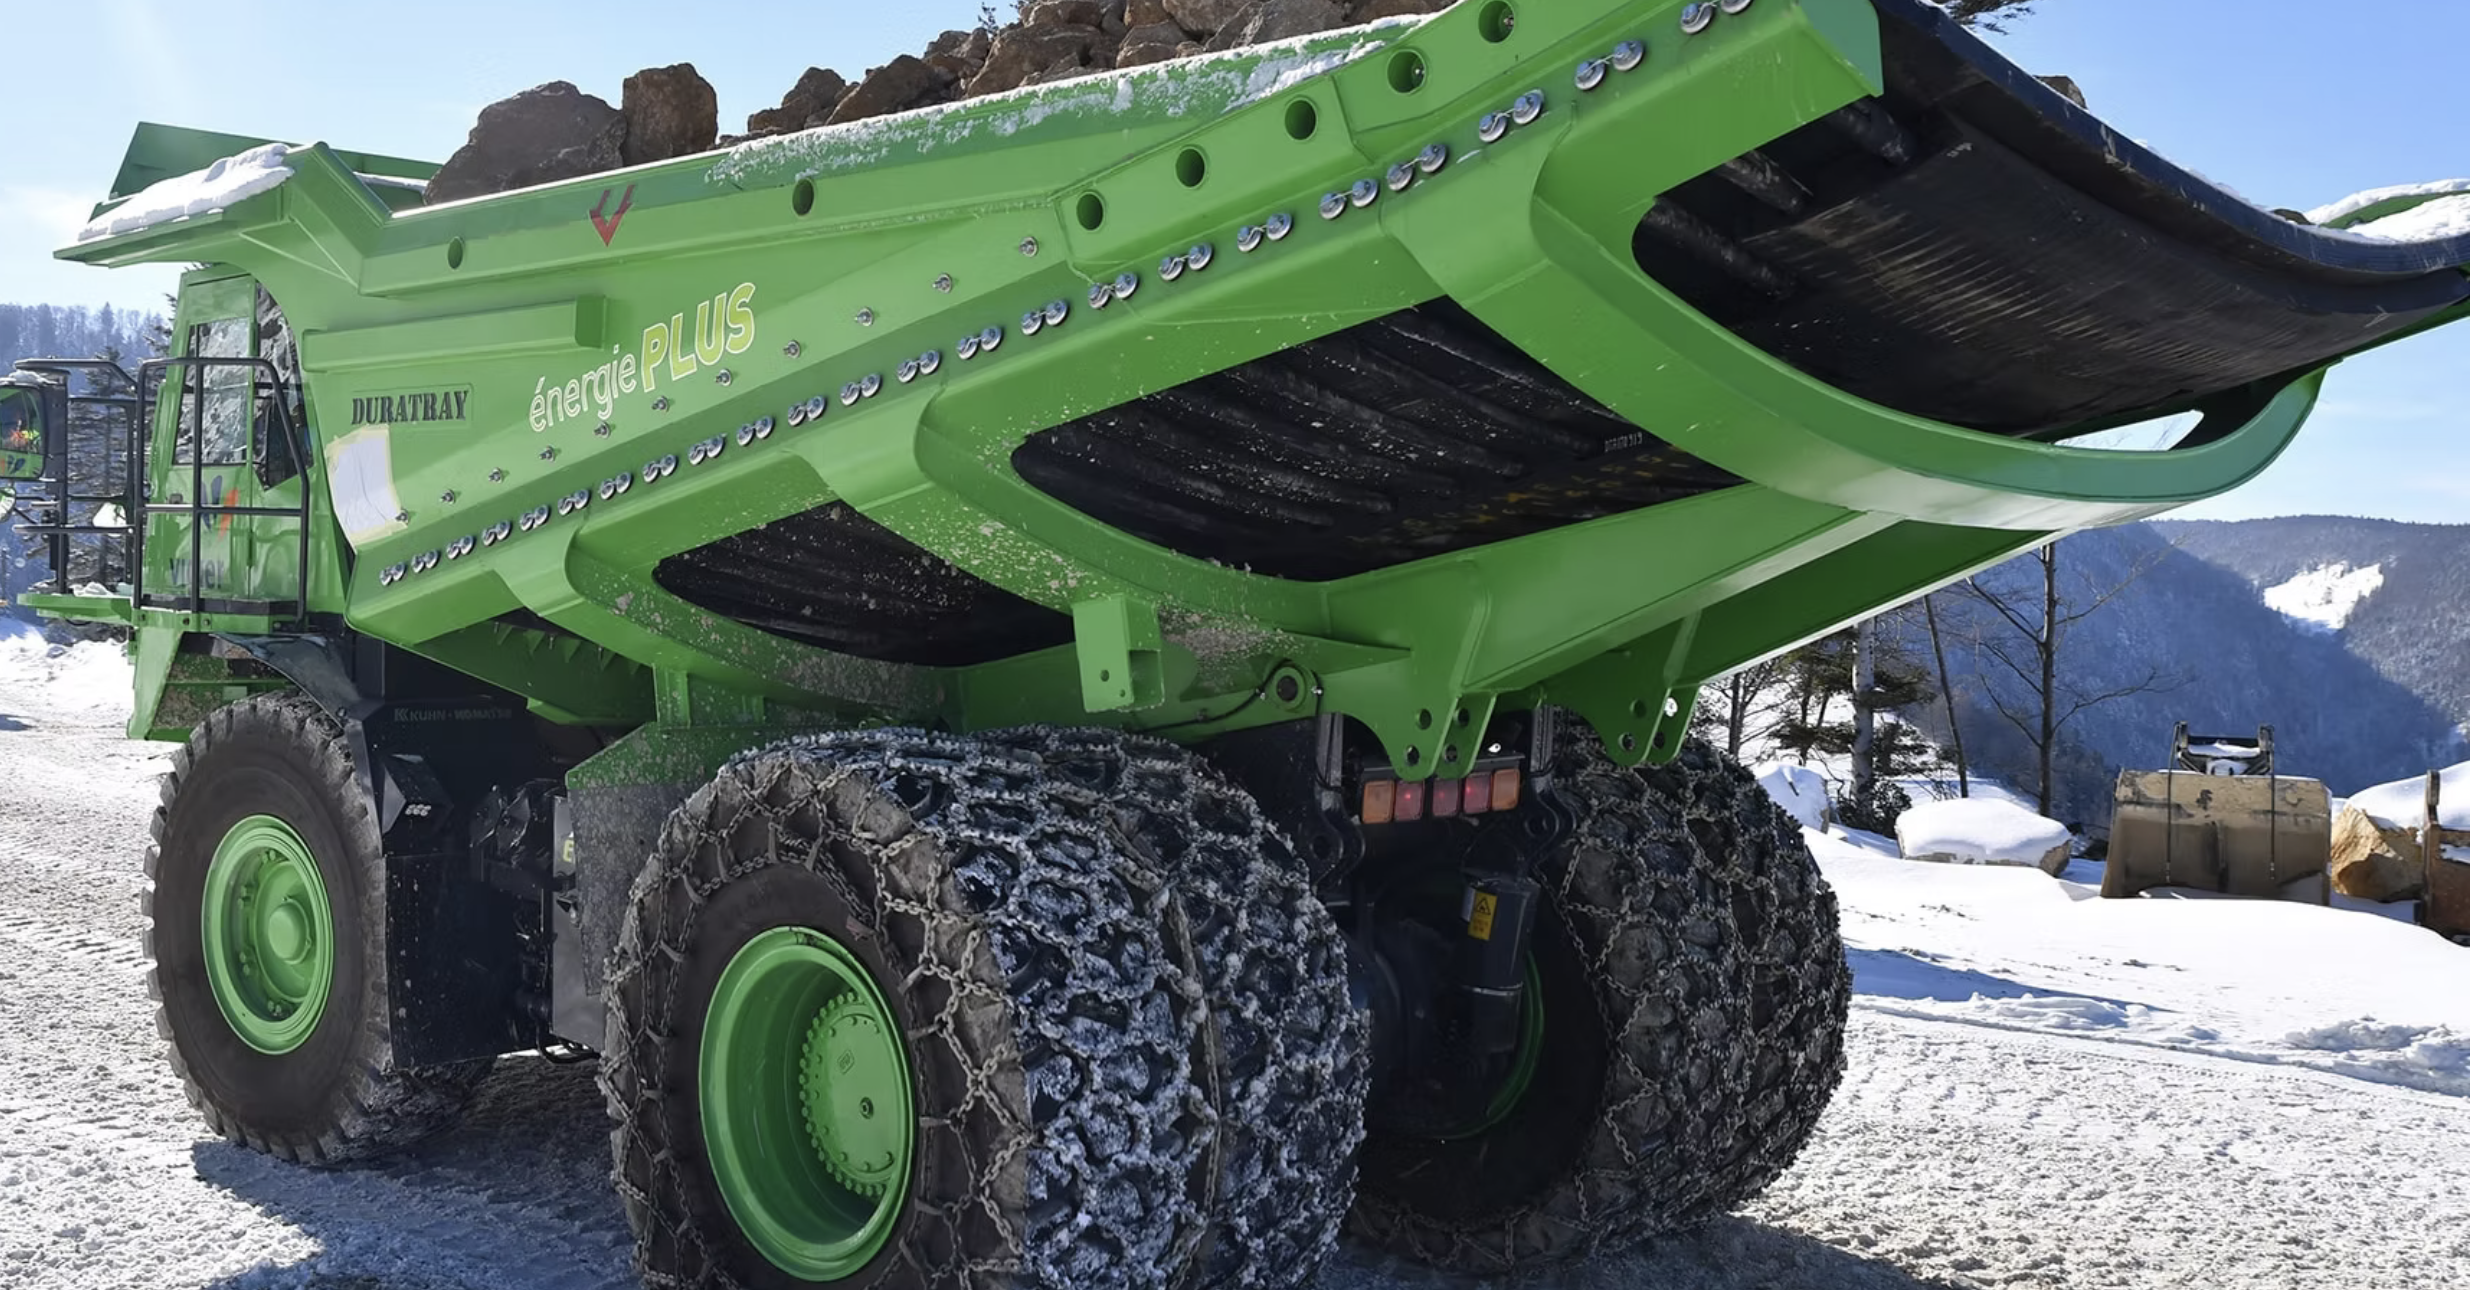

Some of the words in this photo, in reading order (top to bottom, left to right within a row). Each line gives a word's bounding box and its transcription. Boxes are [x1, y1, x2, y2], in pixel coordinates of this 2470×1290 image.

[529, 343, 637, 432] énergie
[641, 281, 756, 393] PLUS
[351, 390, 469, 425] DURATRAY
